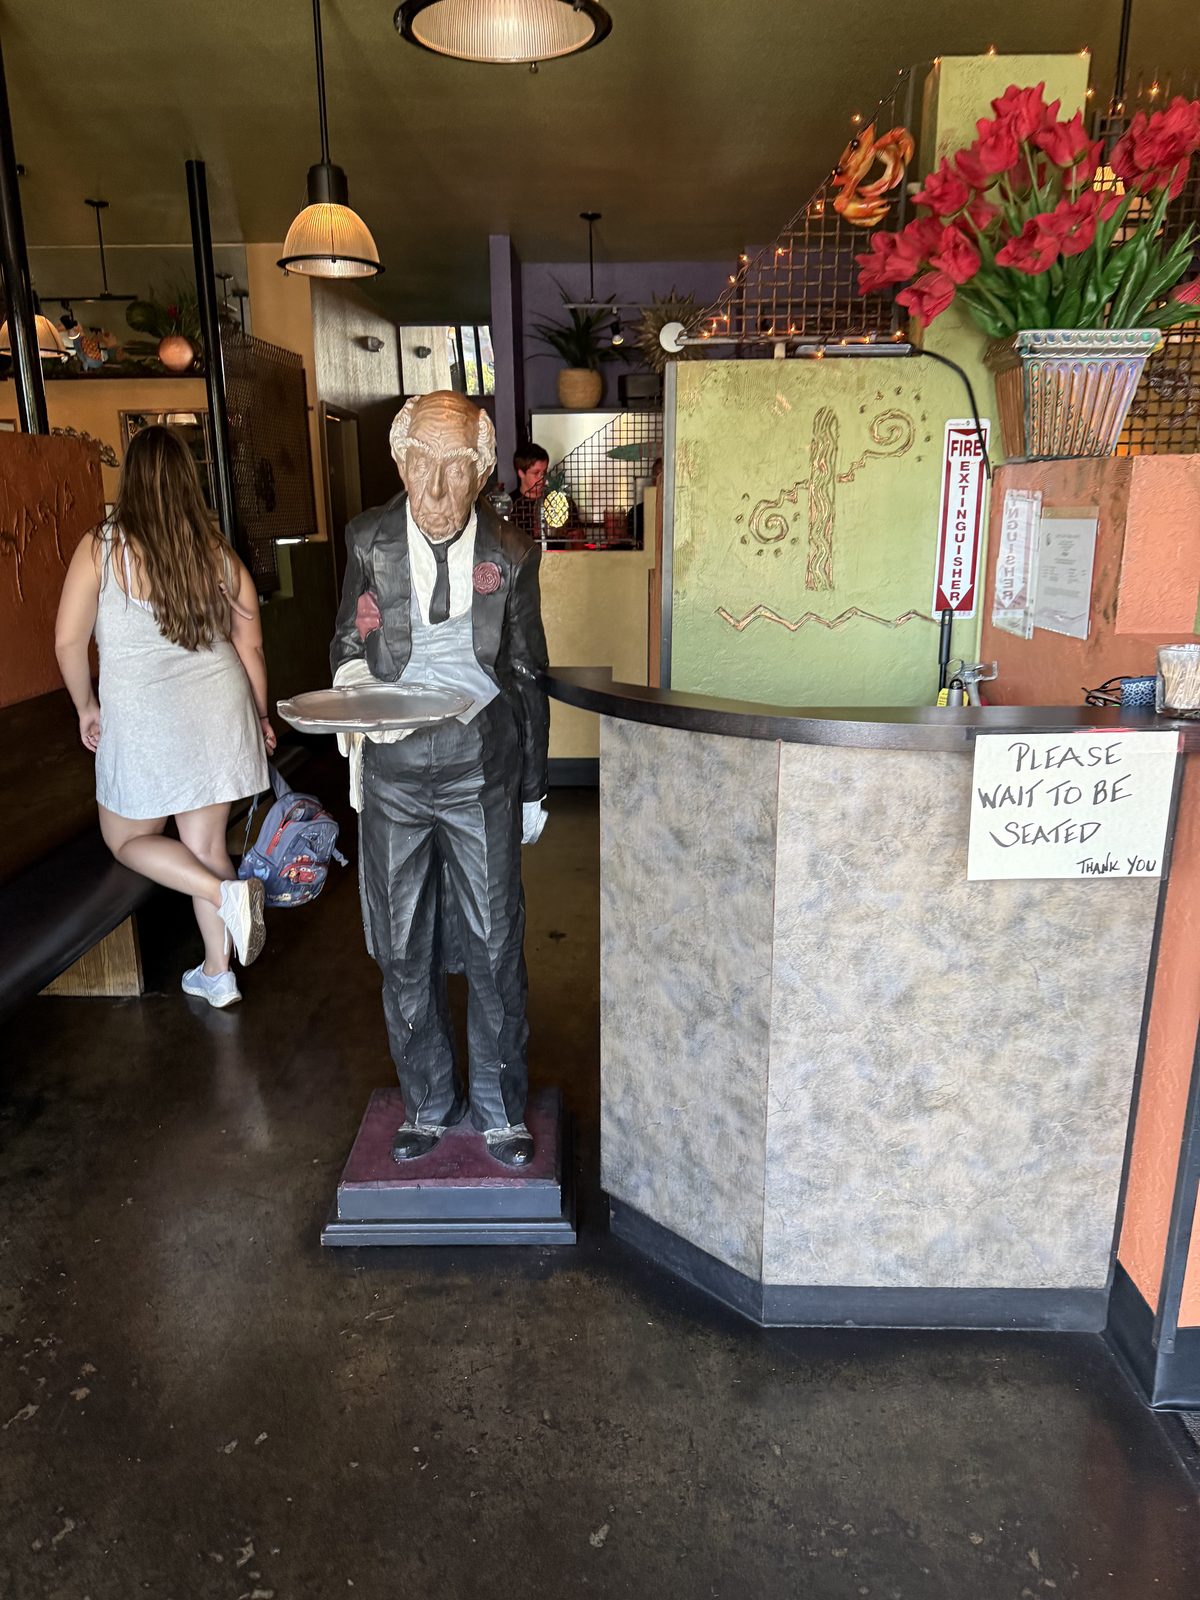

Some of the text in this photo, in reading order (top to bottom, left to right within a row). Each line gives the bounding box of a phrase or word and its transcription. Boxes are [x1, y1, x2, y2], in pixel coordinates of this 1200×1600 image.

[951, 440, 982, 456] FIRE
[950, 461, 970, 601] EXTINGUISHER
[1008, 742, 1122, 772] PLEASE
[978, 774, 1132, 809] WAIT TO BE
[989, 819, 1101, 848] SEATED
[1076, 852, 1156, 875] THANK YOU
